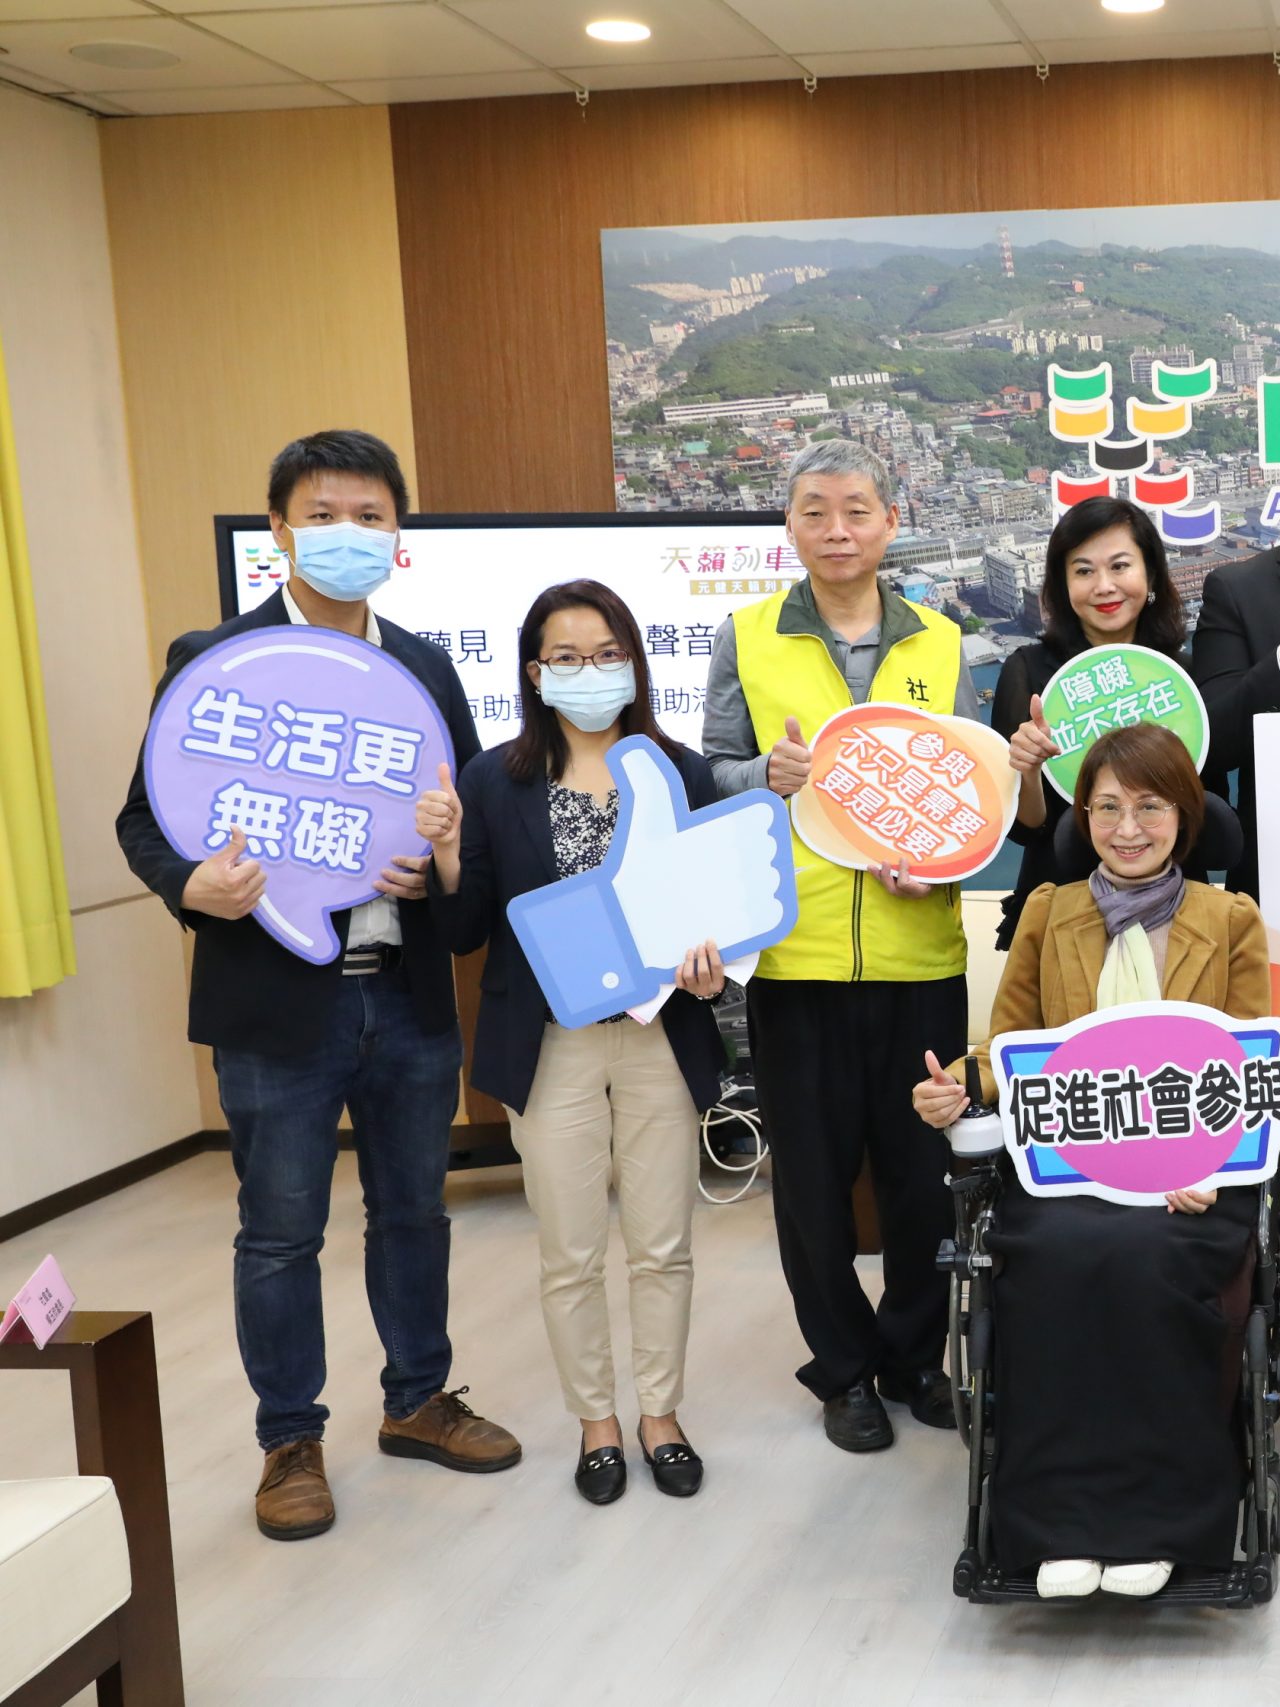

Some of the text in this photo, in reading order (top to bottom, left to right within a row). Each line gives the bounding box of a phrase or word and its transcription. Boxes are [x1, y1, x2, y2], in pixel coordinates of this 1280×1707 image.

[646, 622, 716, 658] 聲音
[906, 677, 930, 702] 社
[1050, 679, 1181, 760] 並不存在
[1059, 655, 1133, 711] 障礙
[183, 688, 422, 795] 生活更
[910, 732, 977, 785] 參與
[817, 764, 943, 862] 更是必要
[840, 726, 987, 843] 不只是需要
[207, 782, 371, 871] 無礙
